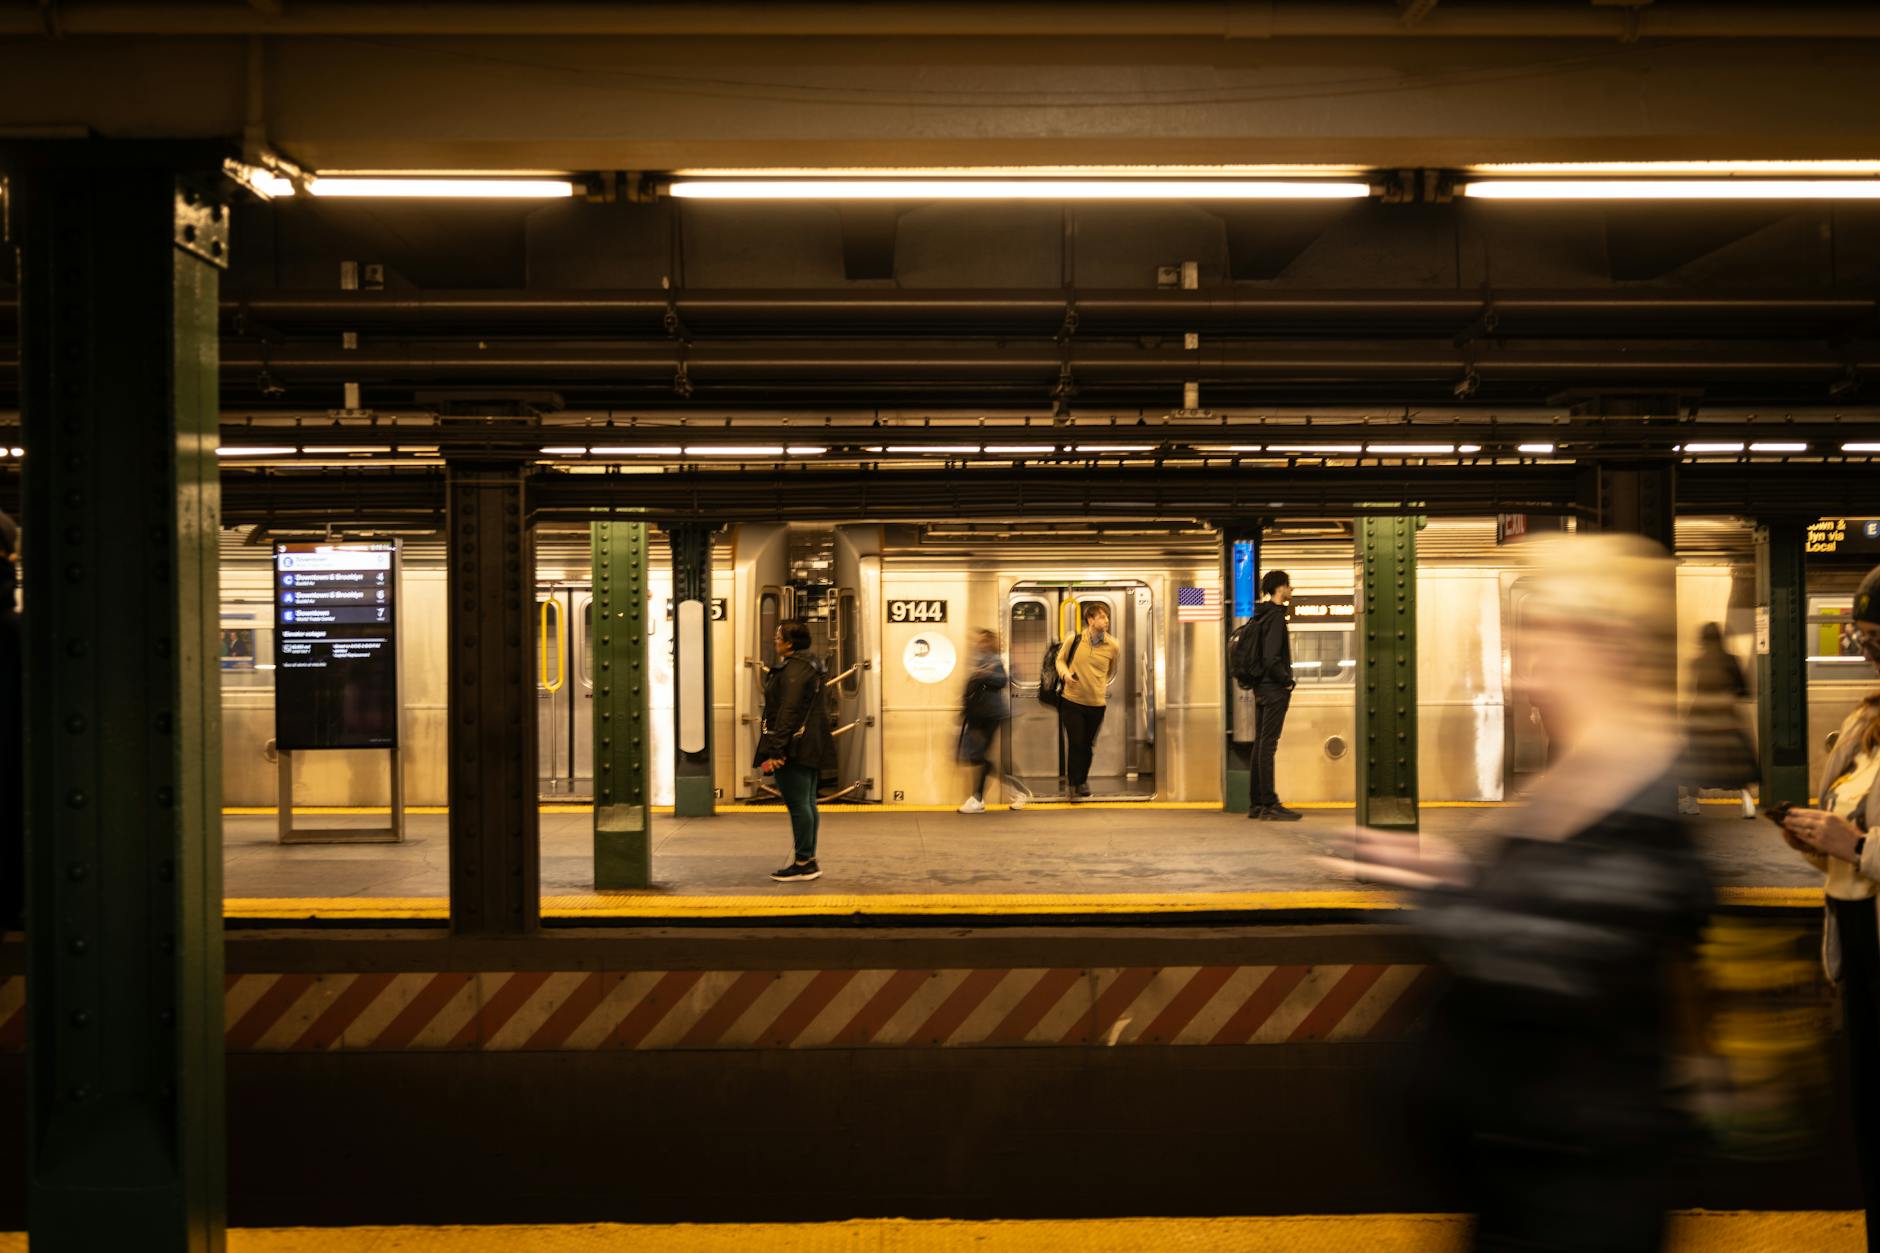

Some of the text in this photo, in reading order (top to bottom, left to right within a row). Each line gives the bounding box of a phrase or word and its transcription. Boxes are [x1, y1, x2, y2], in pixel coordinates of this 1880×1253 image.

[1836, 518, 1846, 531] &
[1867, 523, 1877, 536] E
[1827, 530, 1845, 541] via
[1805, 541, 1837, 552] Local
[283, 574, 293, 585] C
[295, 573, 329, 581] Downtown
[335, 573, 364, 582] Brooklyn
[376, 572, 384, 581] 4
[283, 593, 293, 604] A
[335, 591, 364, 600] Brooklyn
[376, 590, 384, 599] 6
[284, 607, 385, 621] E Downtown 7
[891, 601, 943, 622] 9144
